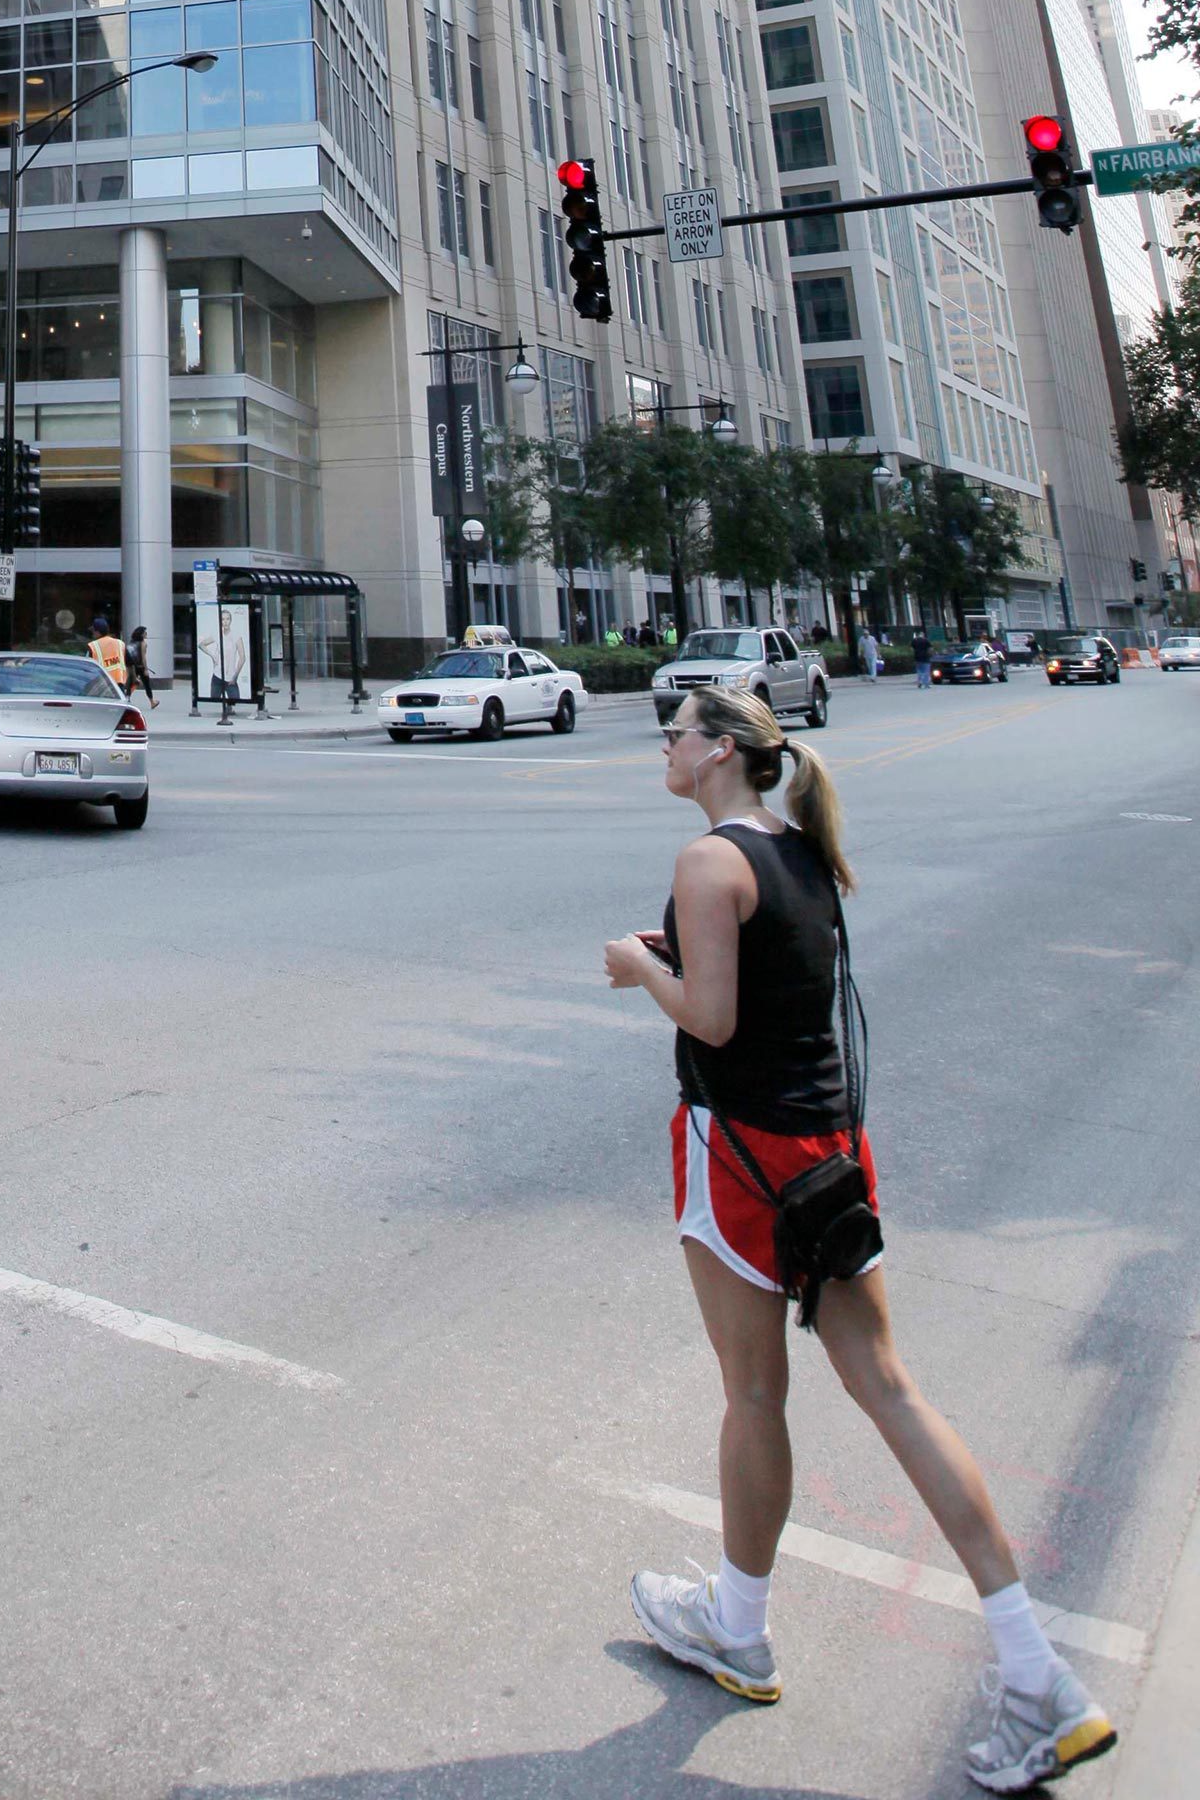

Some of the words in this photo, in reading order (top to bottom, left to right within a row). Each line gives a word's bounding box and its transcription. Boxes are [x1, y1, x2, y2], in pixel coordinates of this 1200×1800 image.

[1097, 159, 1109, 172] N
[666, 195, 694, 211] LEFT
[698, 192, 714, 207] ON
[673, 208, 711, 226] GREEN
[674, 224, 714, 241] ARROW
[681, 240, 709, 256] ONLY
[435, 422, 448, 477] Campus
[460, 404, 475, 493] Northwestern
[5, 557, 14, 567] ON
